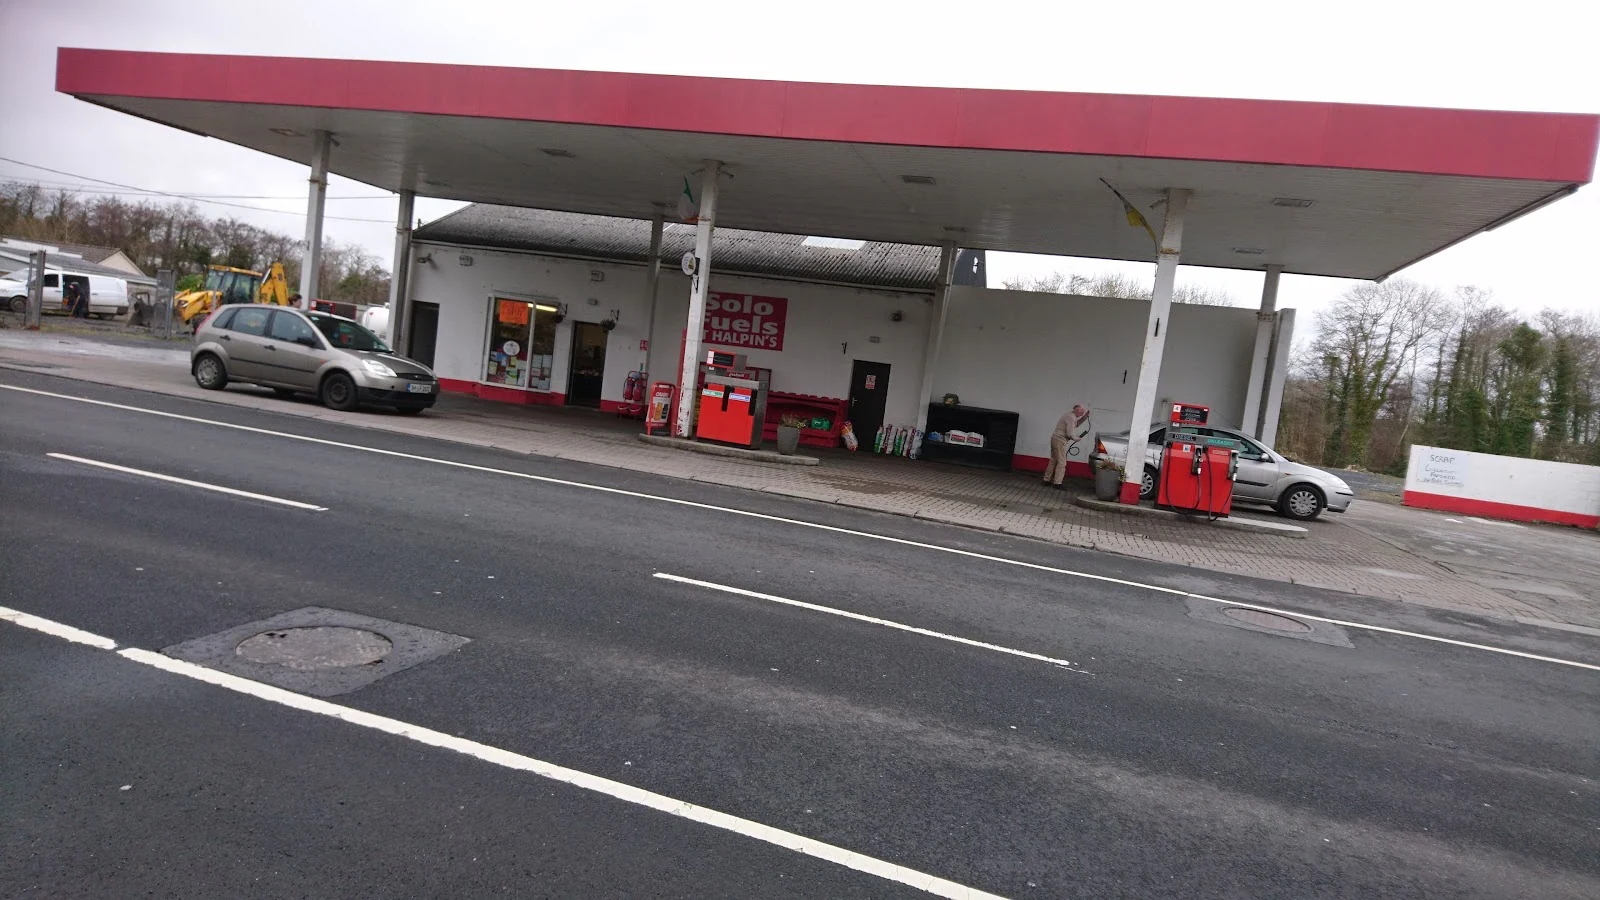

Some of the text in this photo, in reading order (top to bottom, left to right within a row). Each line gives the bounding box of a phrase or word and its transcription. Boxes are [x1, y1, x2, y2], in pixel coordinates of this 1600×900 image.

[706, 293, 774, 316] Solo
[712, 330, 778, 348] HALPIN'S
[1207, 438, 1234, 446] UNLEADED
